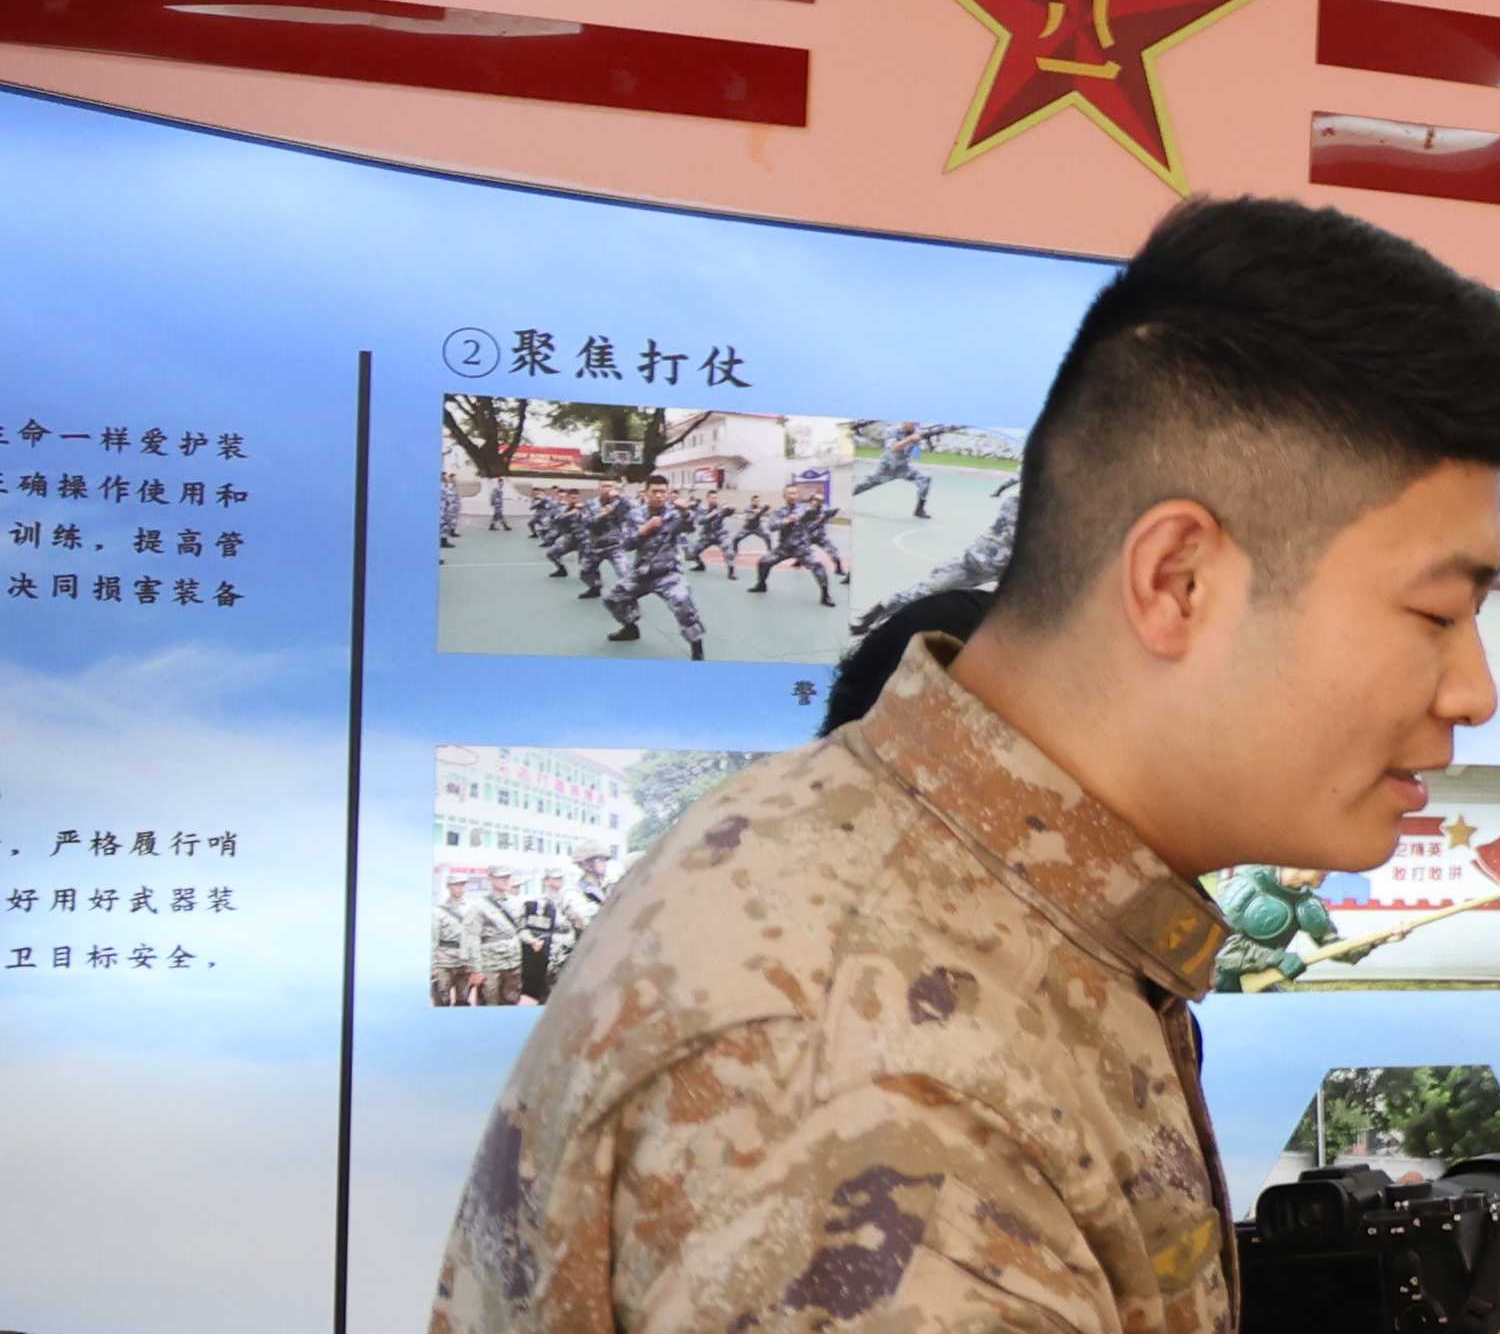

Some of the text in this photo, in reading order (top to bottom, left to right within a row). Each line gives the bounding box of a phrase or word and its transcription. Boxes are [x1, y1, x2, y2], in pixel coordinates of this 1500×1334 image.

[7, 572, 246, 608] 决同损害装备
